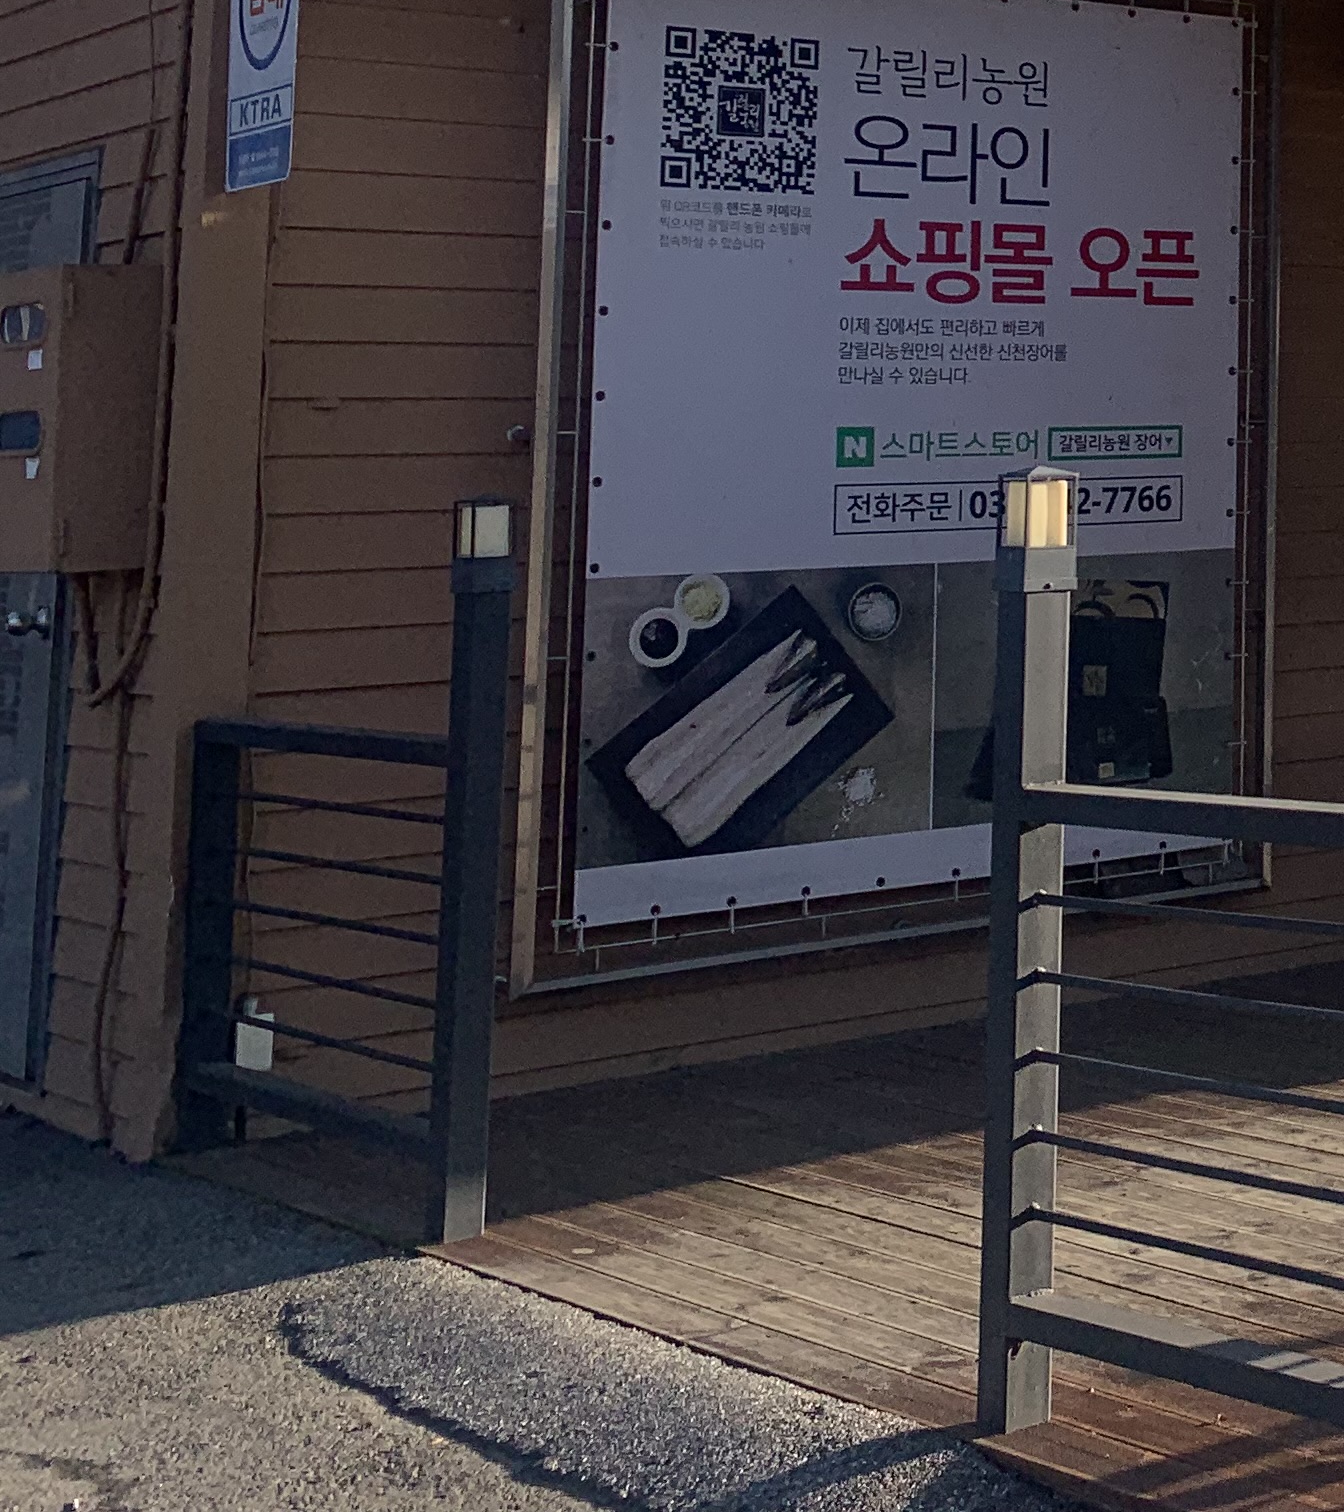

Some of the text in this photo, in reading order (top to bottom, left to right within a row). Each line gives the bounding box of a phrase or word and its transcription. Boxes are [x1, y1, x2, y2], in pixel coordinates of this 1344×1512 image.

[847, 44, 1049, 108] 갈릴리농원
[238, 93, 282, 128] KTRA
[843, 114, 1051, 207] 온라인
[726, 202, 763, 217] 핸드폰
[766, 204, 812, 218] 카메라로
[708, 237, 719, 248] 수
[840, 218, 1200, 306] 쇼핑몰 오픈
[839, 317, 1045, 338] 이제 집에서도 편리하고 빠르게
[838, 341, 944, 361] 갈릴리농원만의
[949, 343, 993, 361] 신선한
[838, 366, 884, 385] 만나실
[889, 368, 904, 384] 수
[880, 429, 1039, 462] 스마트스토어
[1059, 434, 1131, 454] 갈릴리농원
[1135, 433, 1163, 453] 장어
[847, 491, 952, 525] 전화주문
